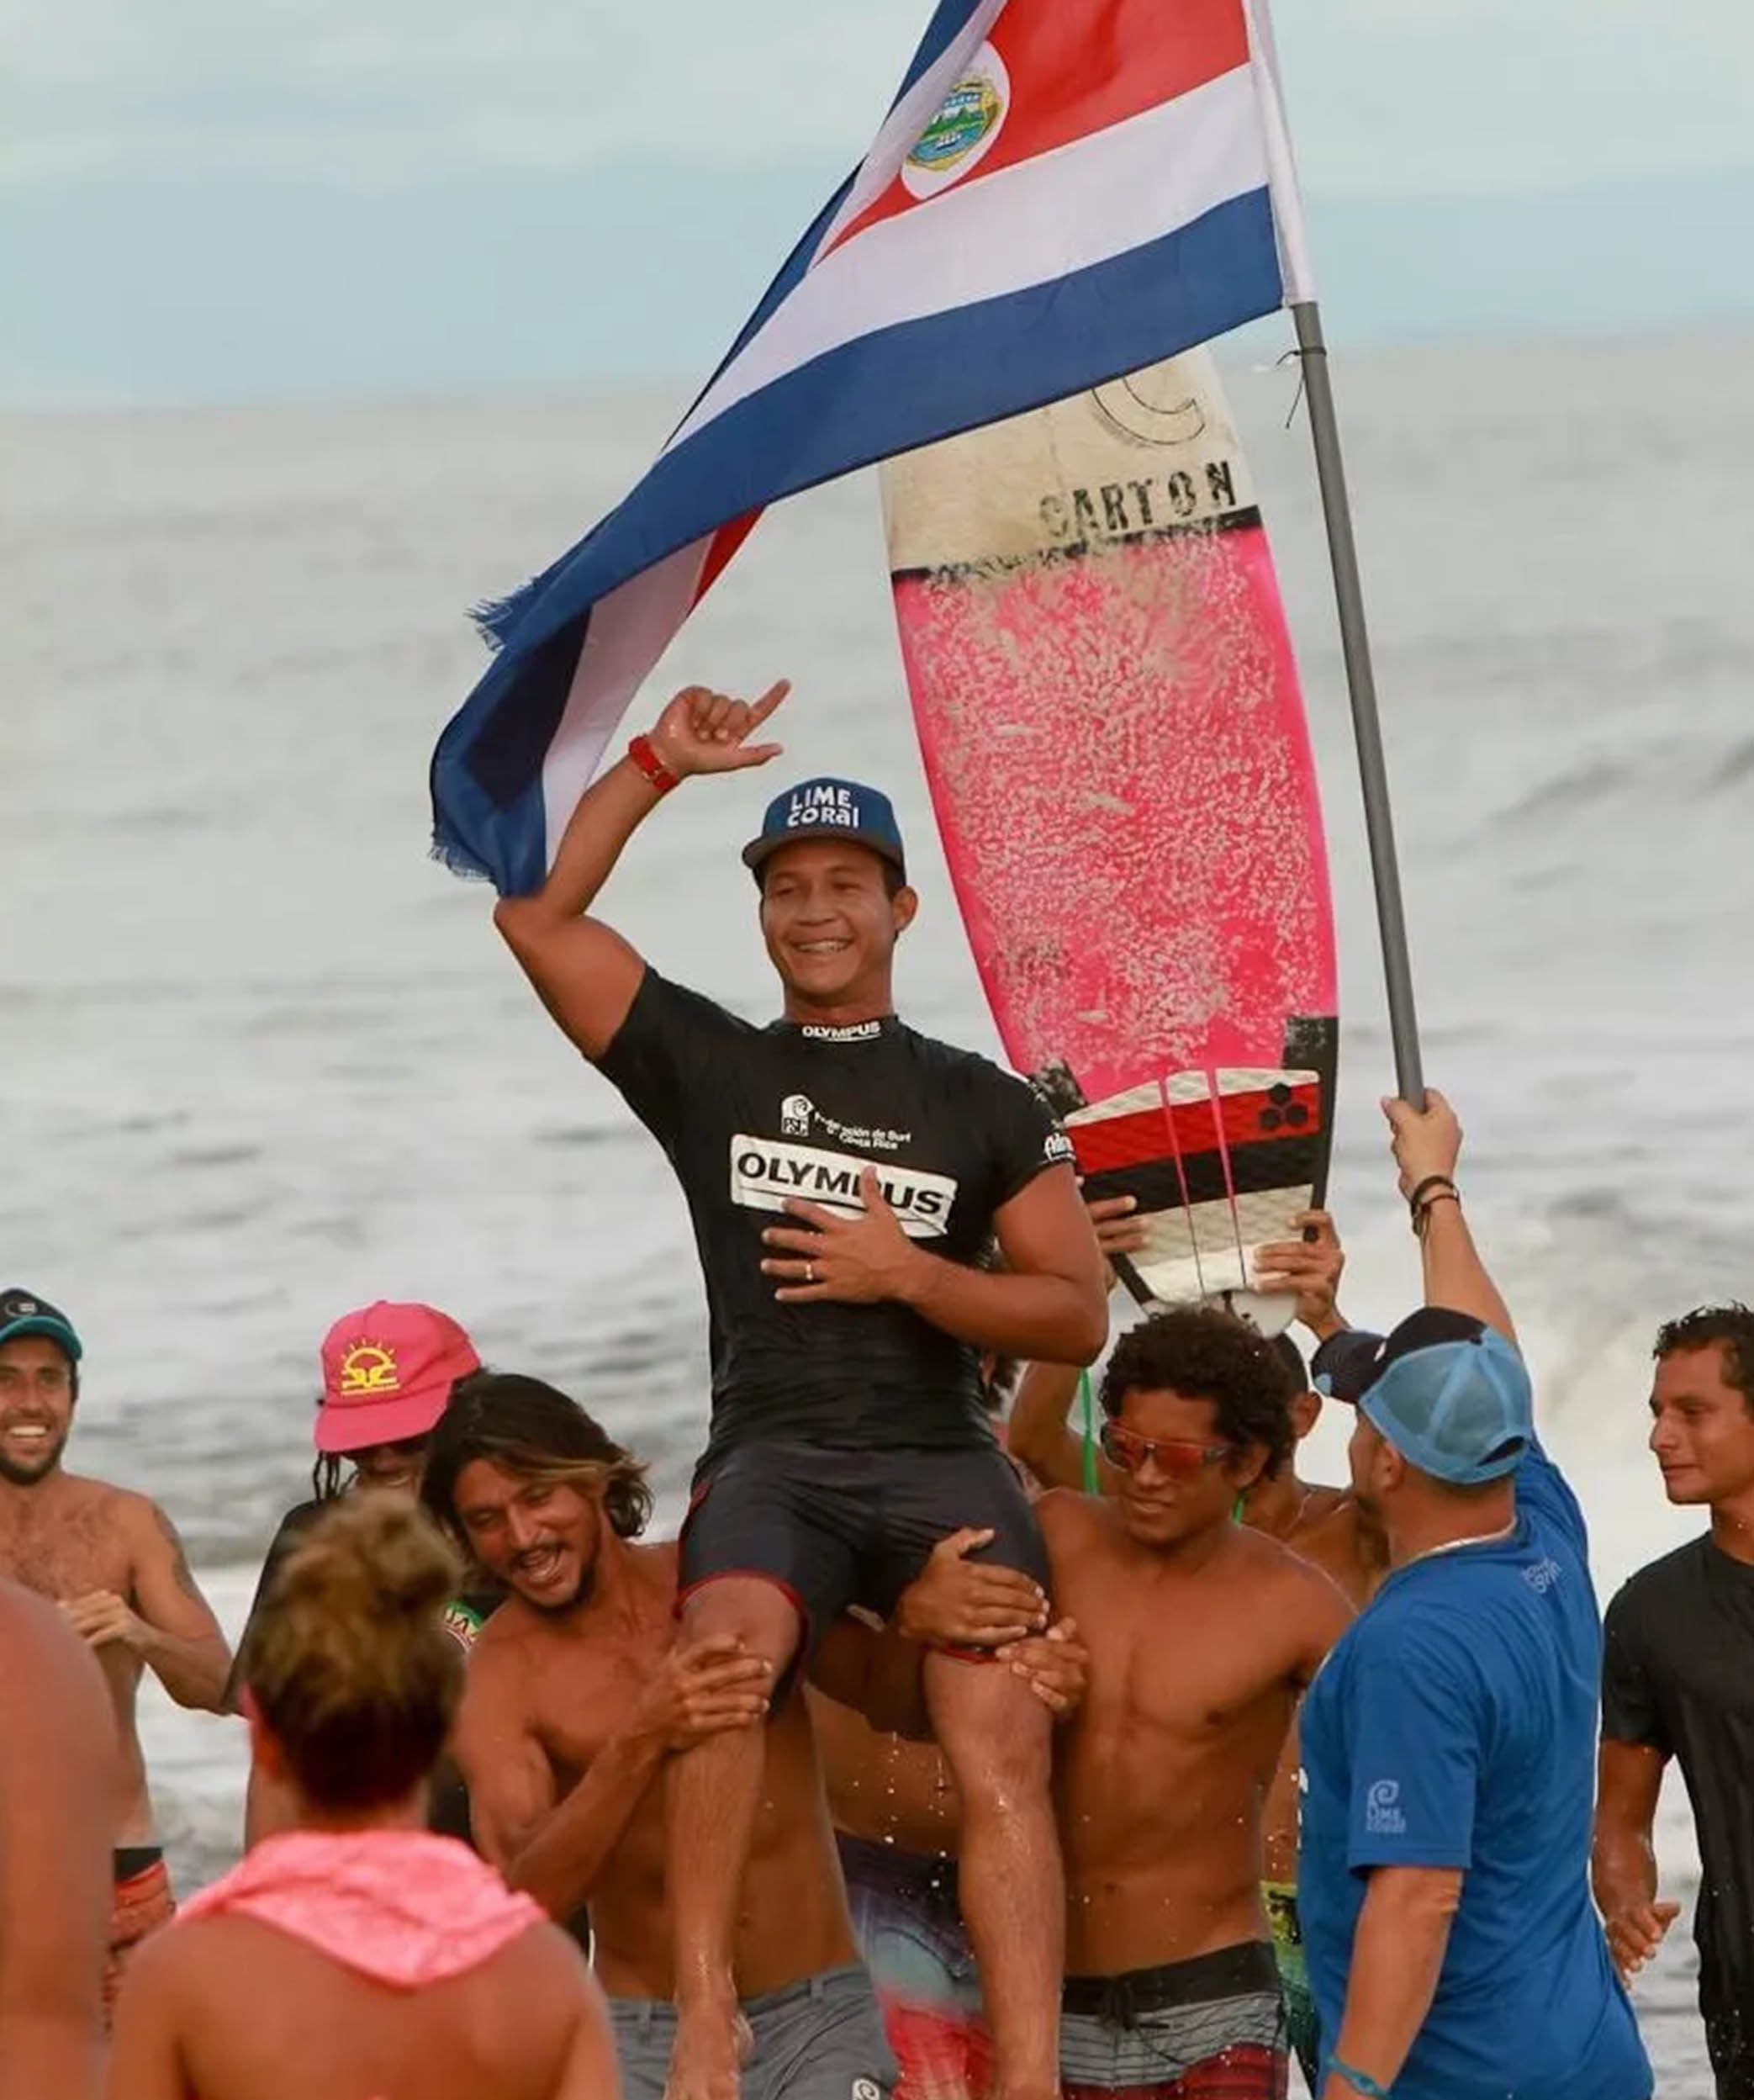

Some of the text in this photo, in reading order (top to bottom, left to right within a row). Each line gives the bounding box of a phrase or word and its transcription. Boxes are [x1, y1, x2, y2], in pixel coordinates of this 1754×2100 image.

[1039, 461, 1236, 537] CARTON
[791, 786, 852, 812] LIME
[801, 1020, 880, 1038] OLYMPUS
